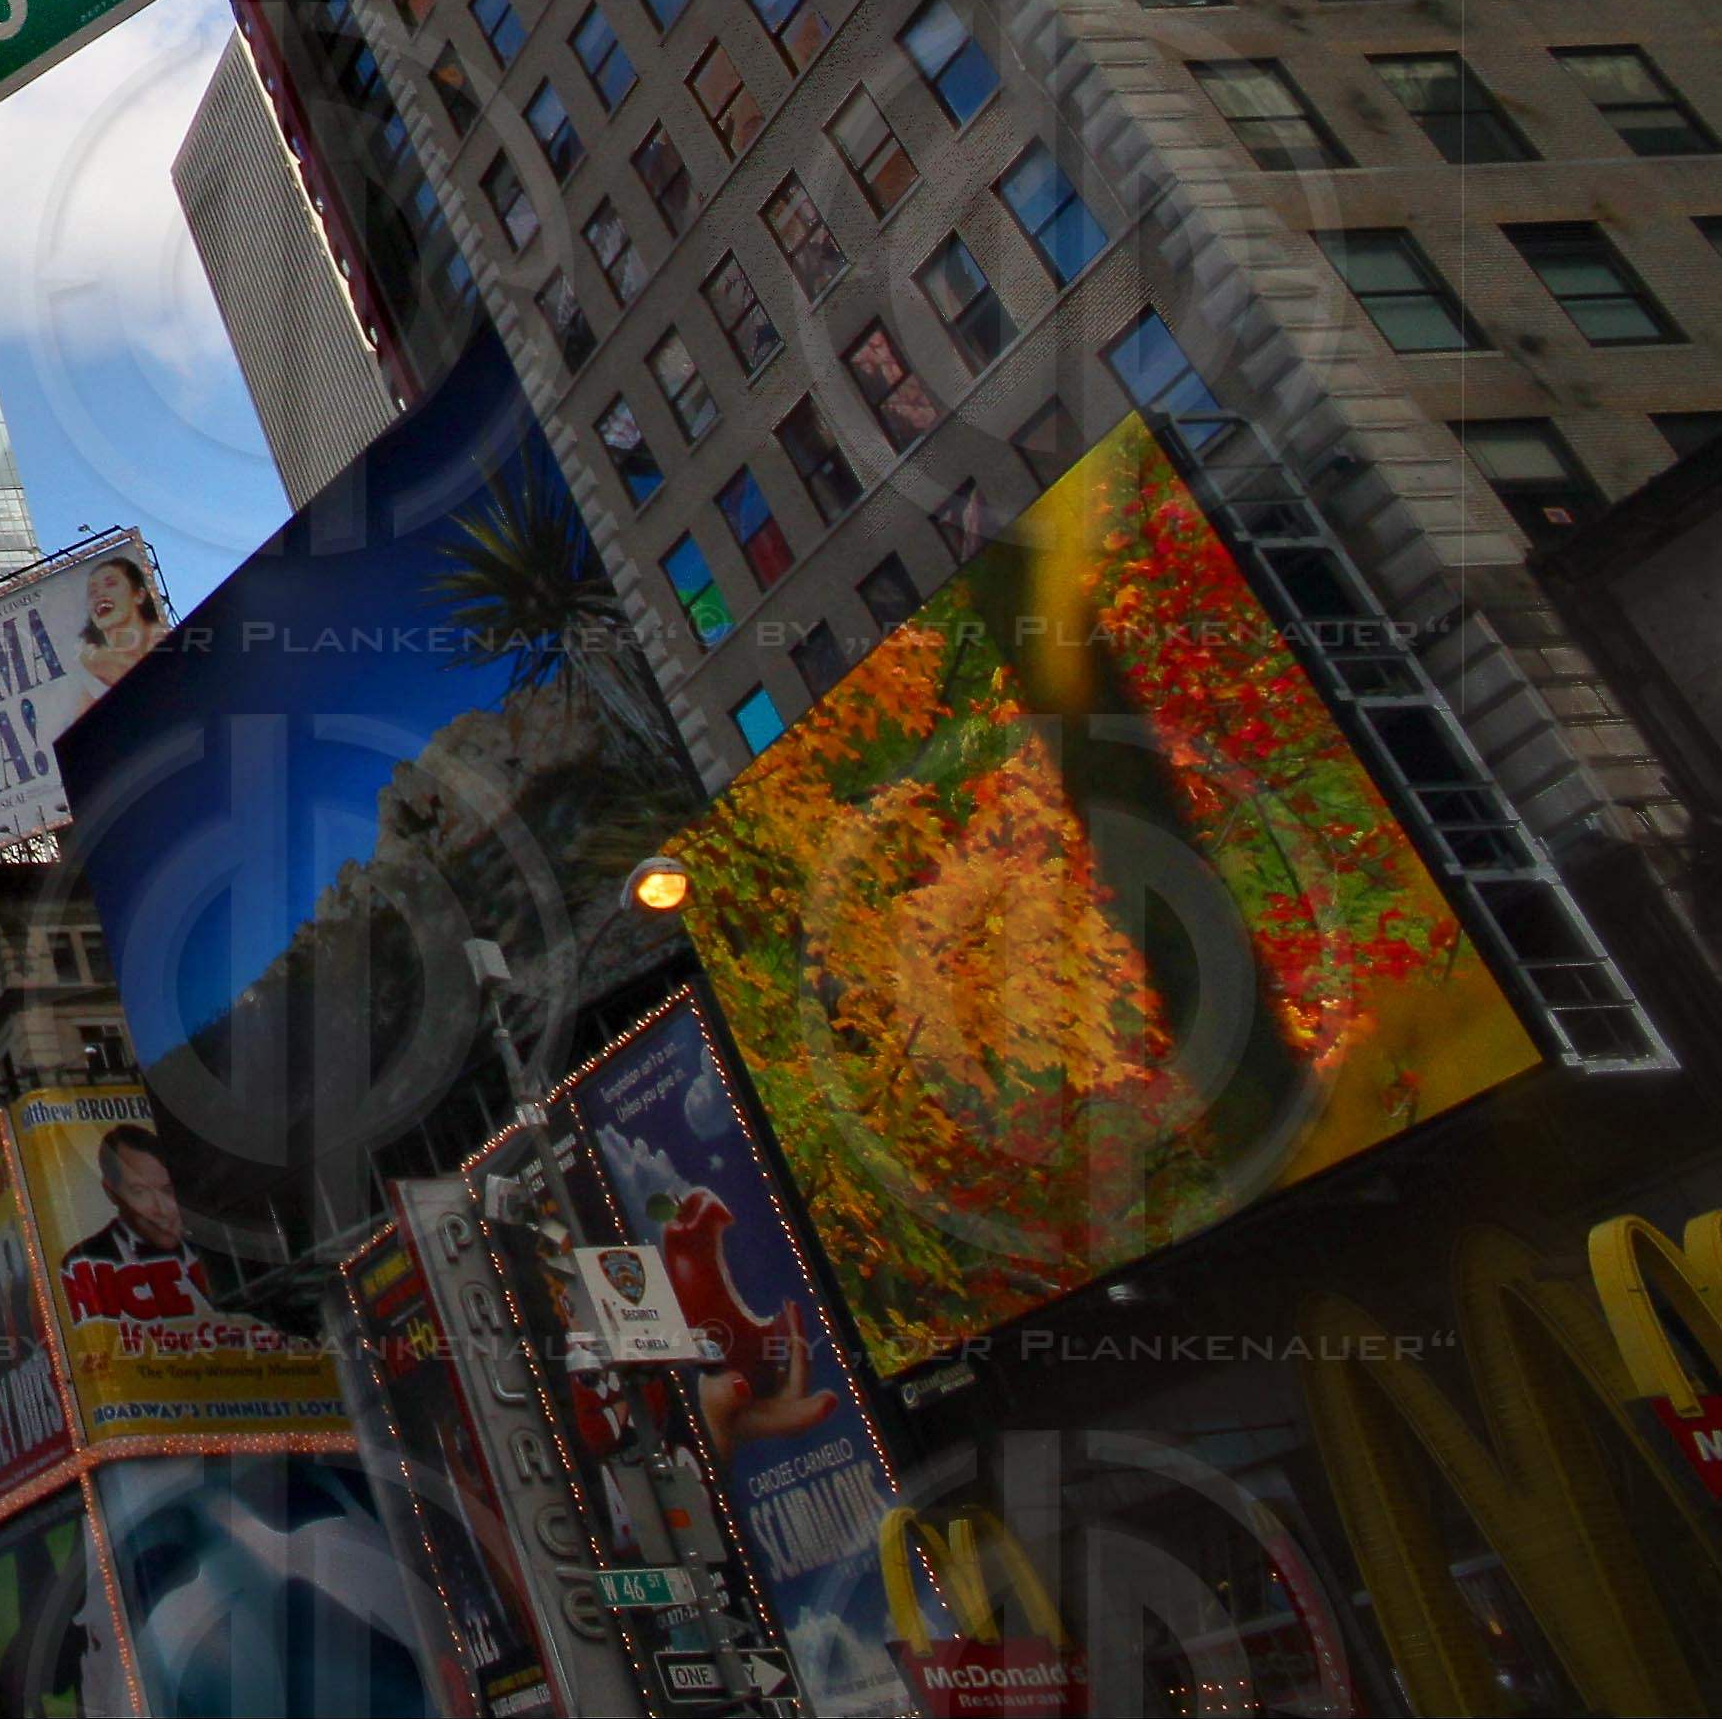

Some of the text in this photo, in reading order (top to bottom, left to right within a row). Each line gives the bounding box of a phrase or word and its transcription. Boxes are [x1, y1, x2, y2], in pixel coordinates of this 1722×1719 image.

[62, 1258, 196, 1323] NICE
[620, 1307, 661, 1323] SECURITY
[118, 1321, 143, 1354] If
[436, 1210, 610, 1642] PALACE
[747, 1437, 855, 1500] CAROLEE CARMELLO
[748, 1459, 890, 1583] SCANDALOUS
[599, 1574, 663, 1602] W 46 ST
[675, 1665, 710, 1687] ONE
[922, 1663, 1086, 1690] McDonald's
